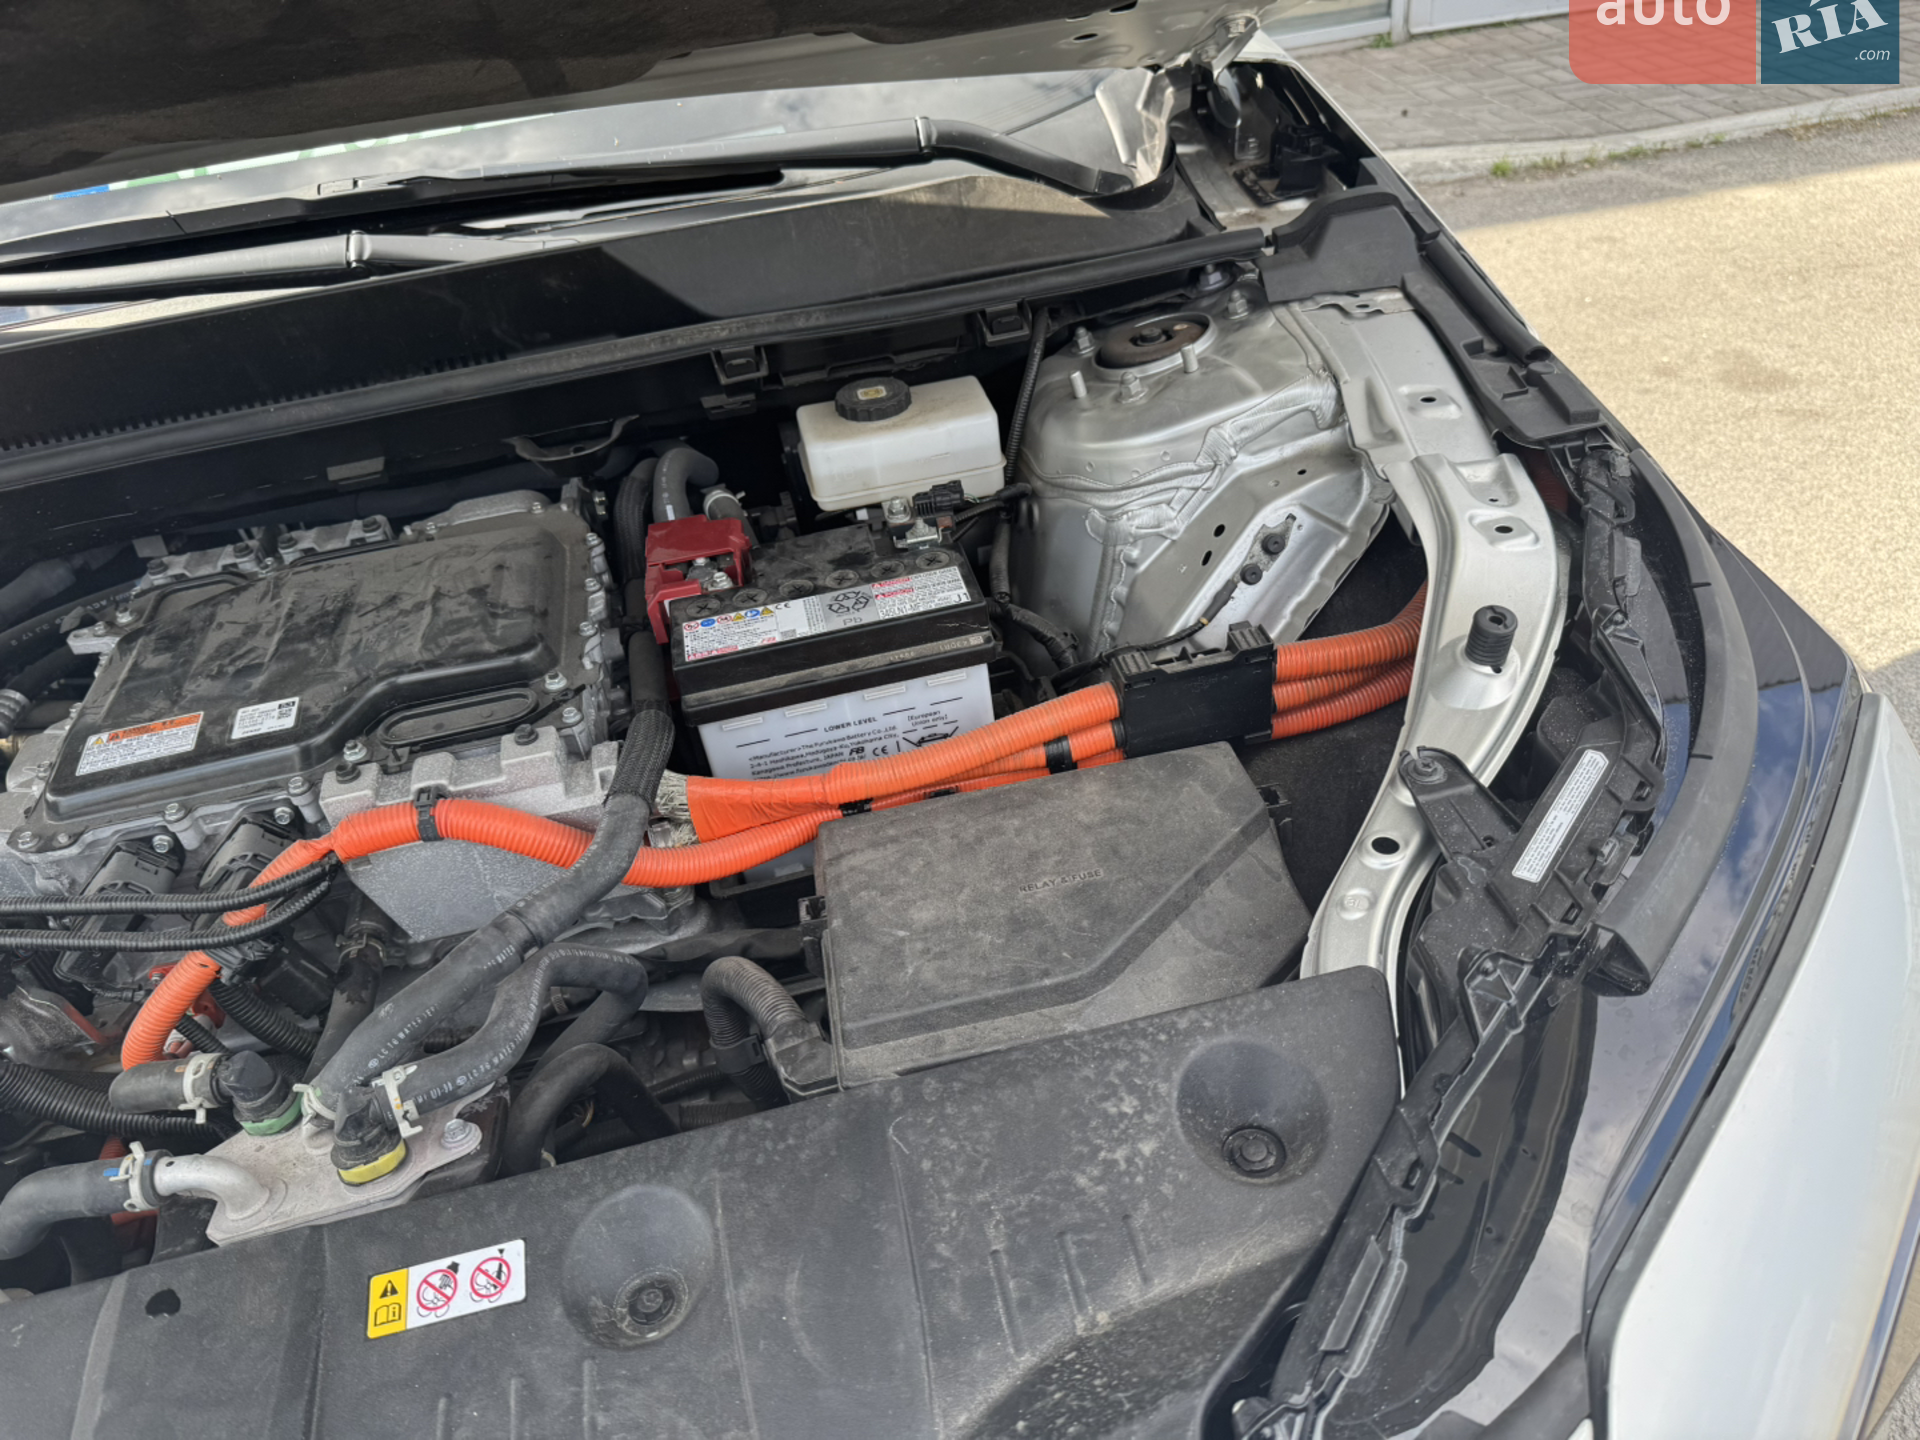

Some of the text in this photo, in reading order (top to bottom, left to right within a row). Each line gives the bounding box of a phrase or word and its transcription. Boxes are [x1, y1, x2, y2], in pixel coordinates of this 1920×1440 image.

[843, 616, 863, 626] Pb
[824, 716, 878, 733] LOWER LEVEL
[1019, 869, 1102, 892] RELAY & FUSE
[397, 1016, 422, 1040] WATER
[493, 1042, 516, 1064] WATER
